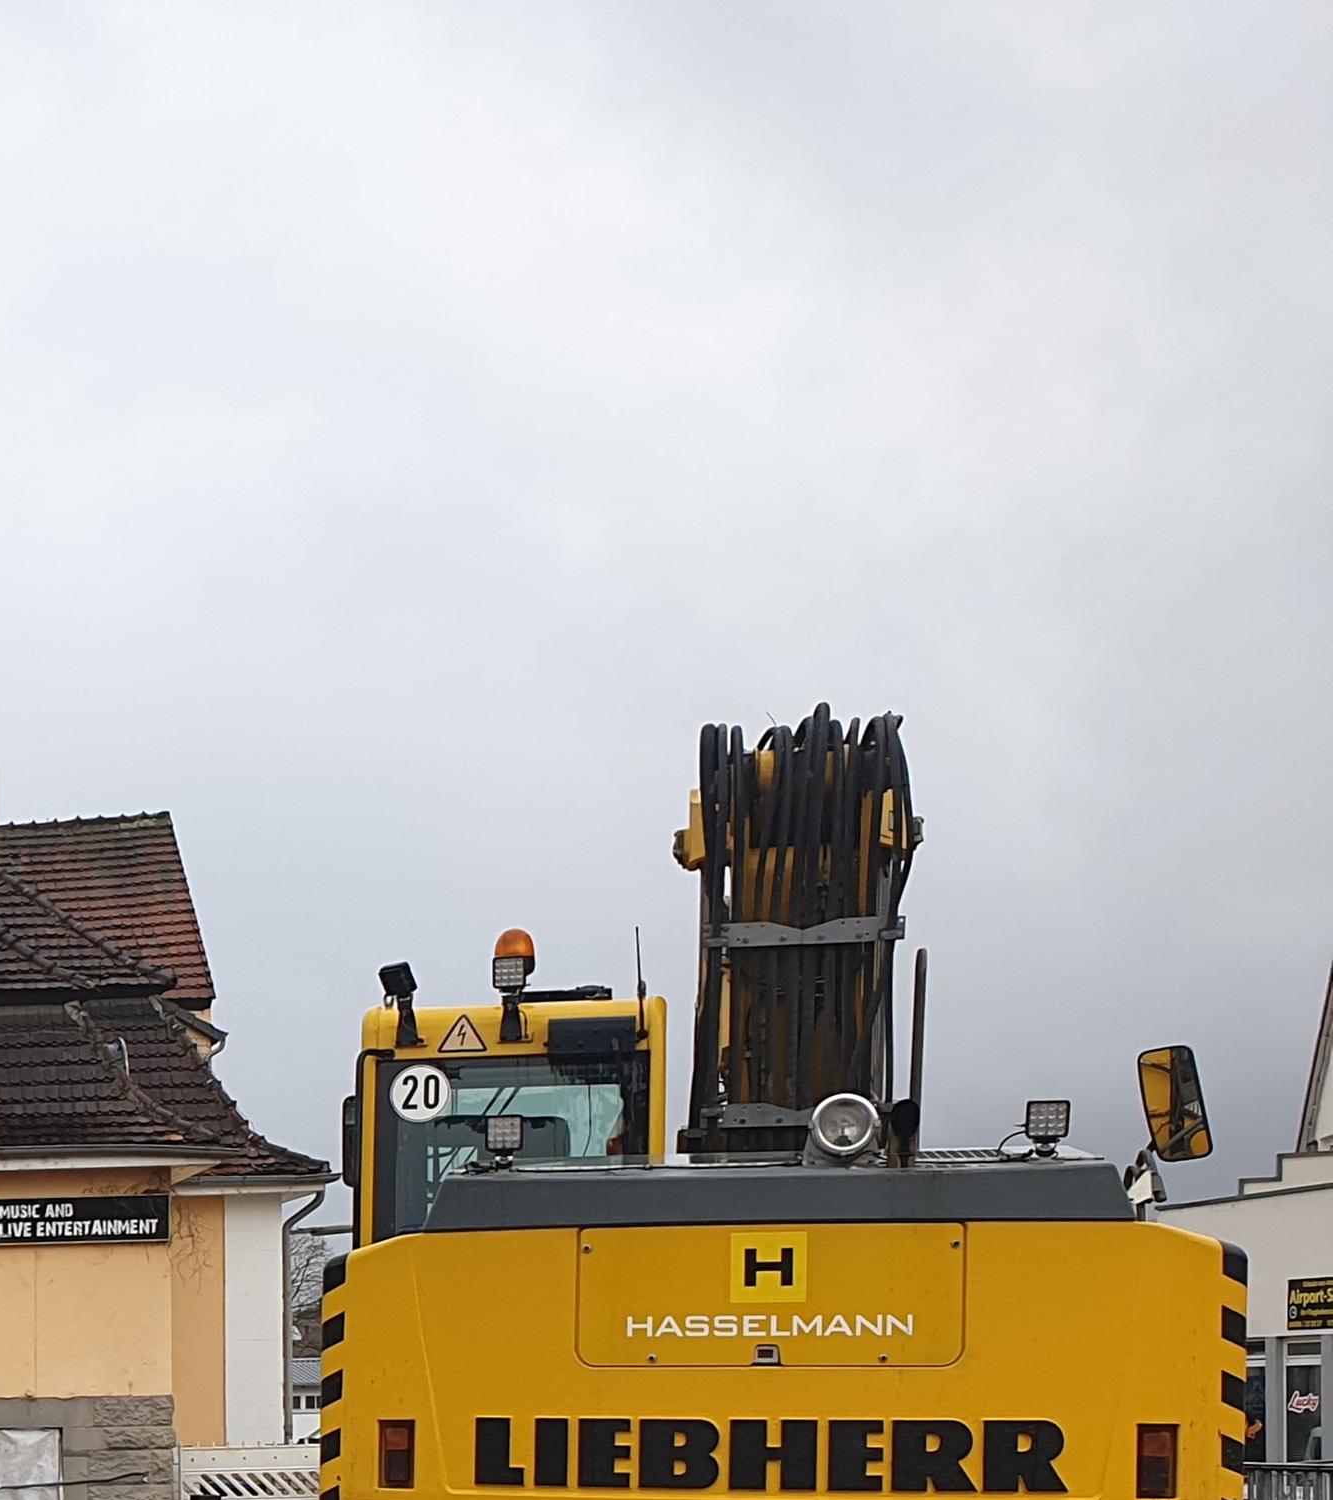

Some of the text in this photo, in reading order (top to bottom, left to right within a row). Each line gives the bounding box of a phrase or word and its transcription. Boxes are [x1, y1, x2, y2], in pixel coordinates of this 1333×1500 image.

[402, 1075, 440, 1110] 20
[0, 1203, 74, 1219] MUSIC AND
[0, 1219, 158, 1238] LIVE ENTERTAINMENT
[744, 1247, 794, 1287] H
[626, 1313, 914, 1338] HASSELMANN
[475, 1417, 1069, 1494] LIEBHERR
